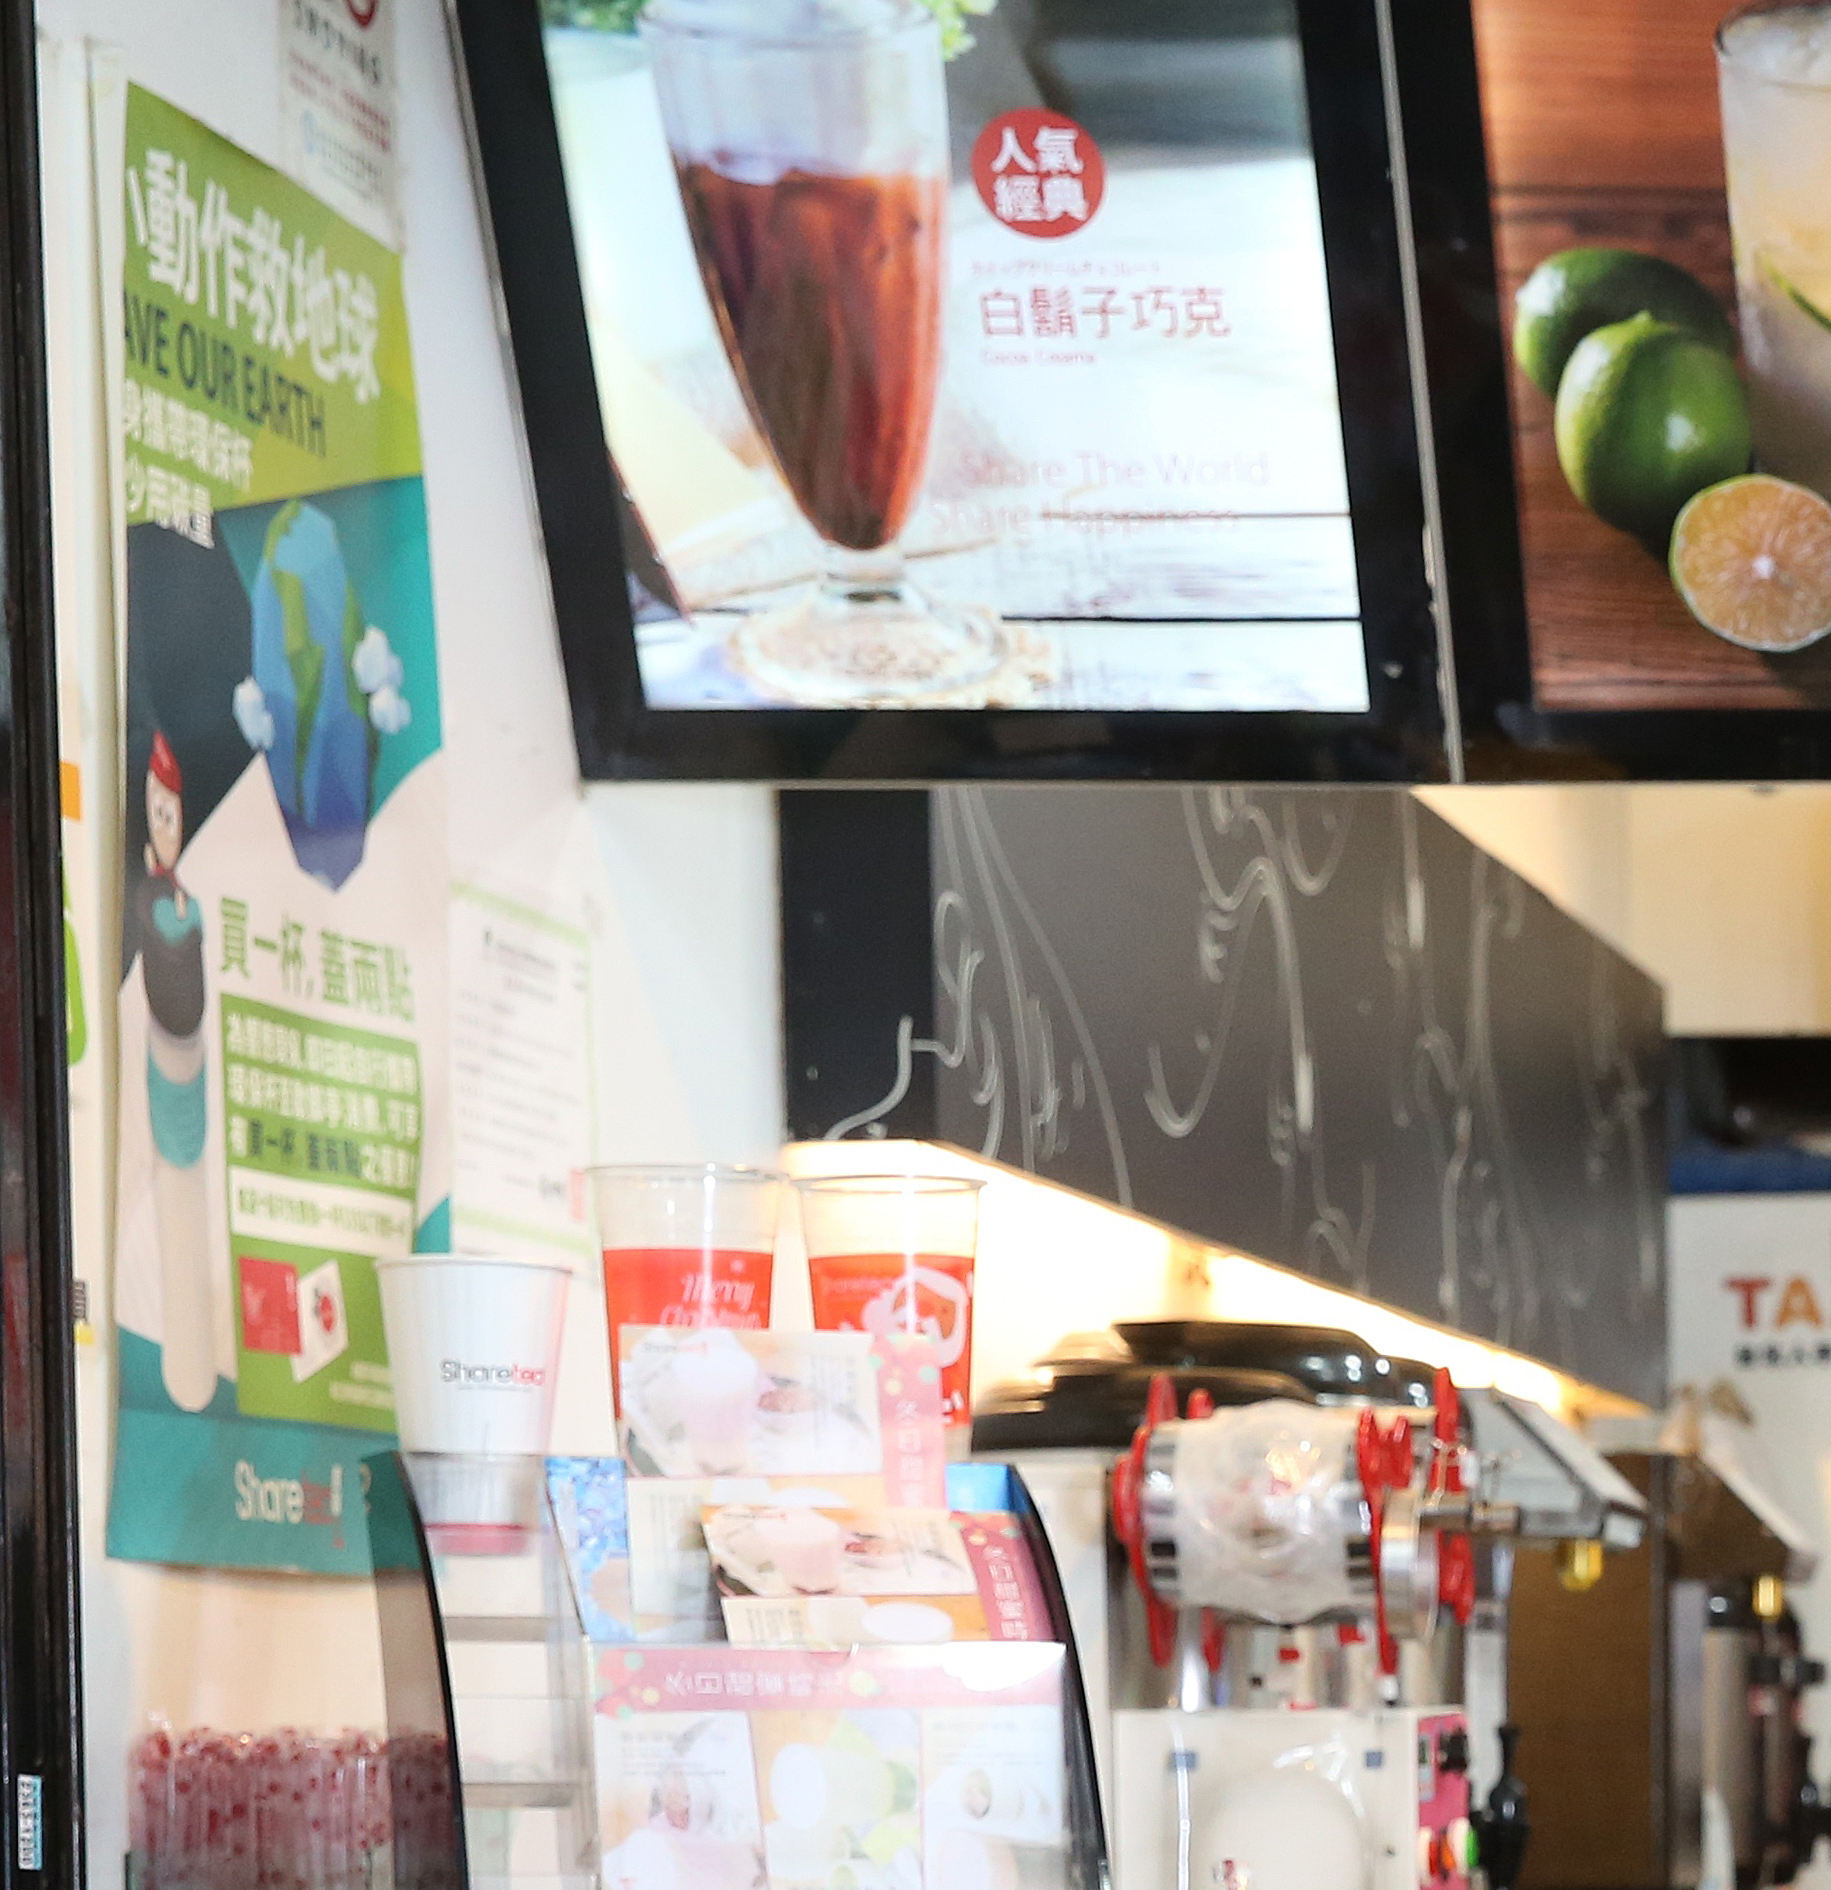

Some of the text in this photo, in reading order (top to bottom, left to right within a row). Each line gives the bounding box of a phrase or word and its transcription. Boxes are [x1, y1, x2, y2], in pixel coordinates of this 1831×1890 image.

[991, 127, 1084, 174] 人氣
[993, 178, 1089, 222] 經典
[177, 322, 239, 414] OUR
[243, 352, 326, 459] EARTH
[959, 451, 1270, 488] Share The World
[930, 502, 1031, 535] Share
[440, 1357, 547, 1386] Sharetea
